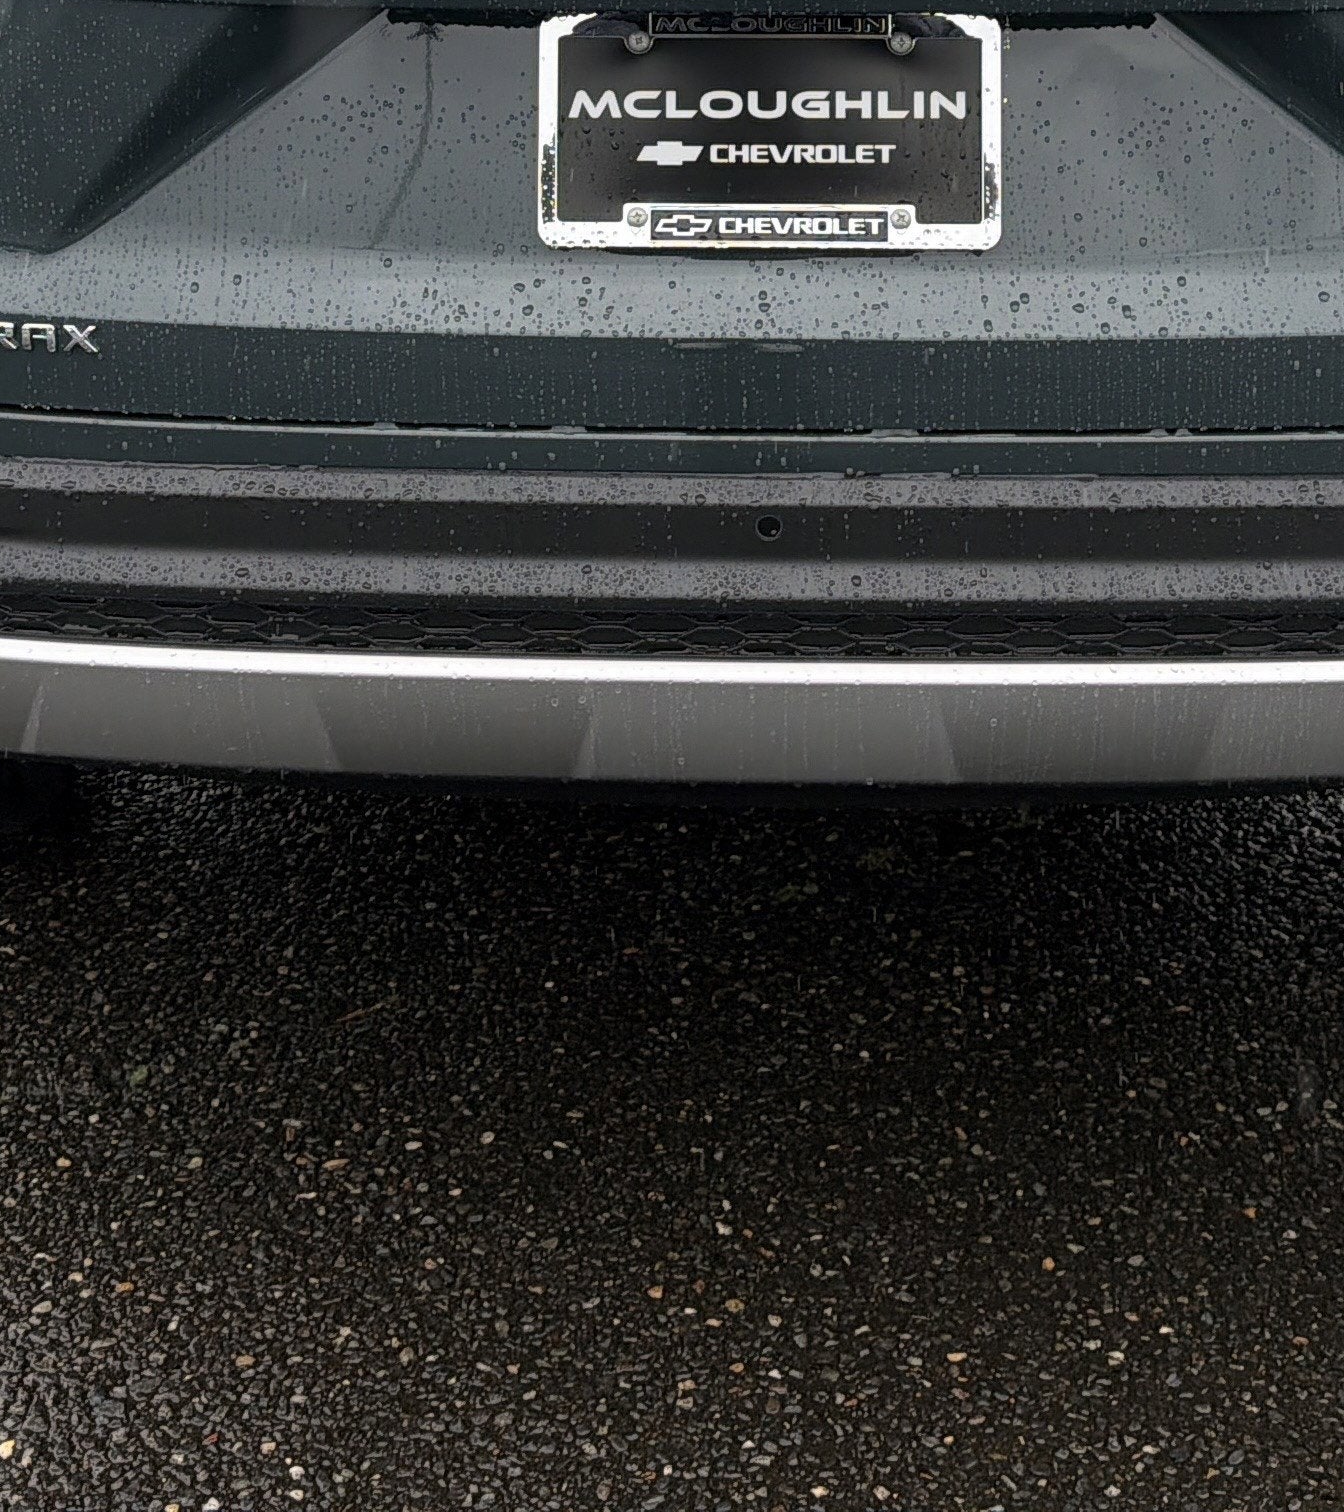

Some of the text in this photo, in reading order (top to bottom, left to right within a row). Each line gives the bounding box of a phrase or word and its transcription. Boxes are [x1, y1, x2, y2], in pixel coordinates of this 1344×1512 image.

[567, 90, 967, 120] MCLOUGHLIN
[709, 144, 897, 164] CHEVROLET
[718, 218, 884, 236] CHEVROLET
